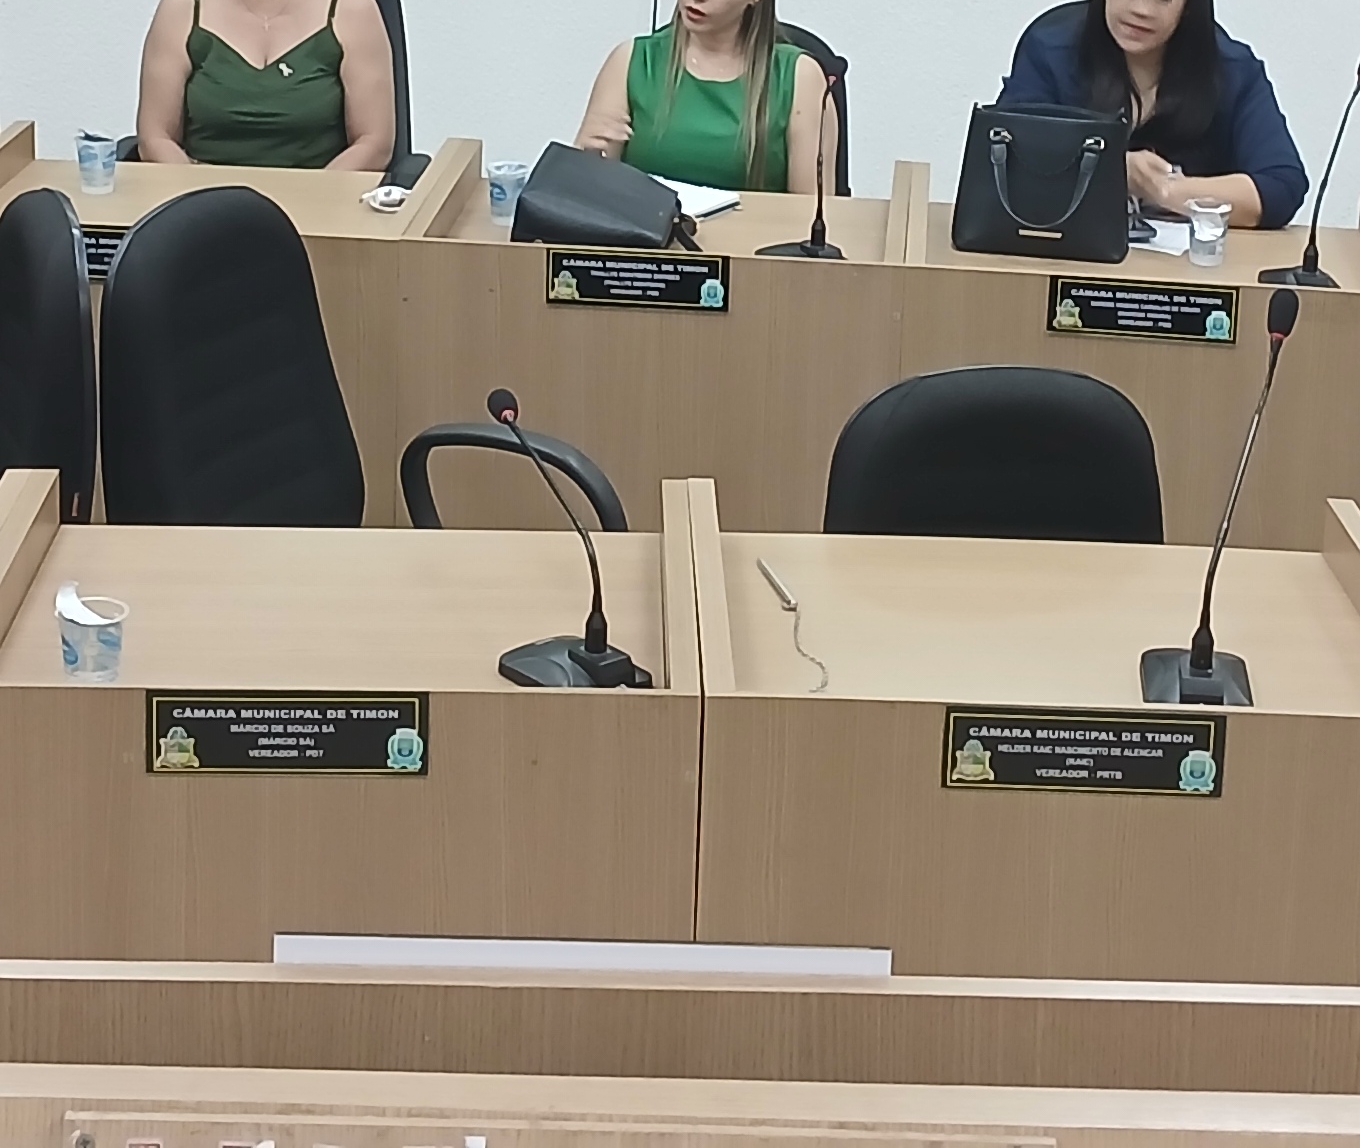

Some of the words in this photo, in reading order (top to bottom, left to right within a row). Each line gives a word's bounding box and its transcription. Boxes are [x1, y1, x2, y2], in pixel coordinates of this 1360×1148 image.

[172, 707, 237, 719] CÂMARA
[240, 709, 323, 719] MUNICIPAL
[326, 709, 347, 719] DE
[349, 709, 399, 719] TIMON
[968, 725, 1032, 739] CÂMARA
[1035, 729, 1118, 741] MUNICIPAL
[1121, 731, 1141, 742] DE
[1144, 732, 1194, 744] TIMON
